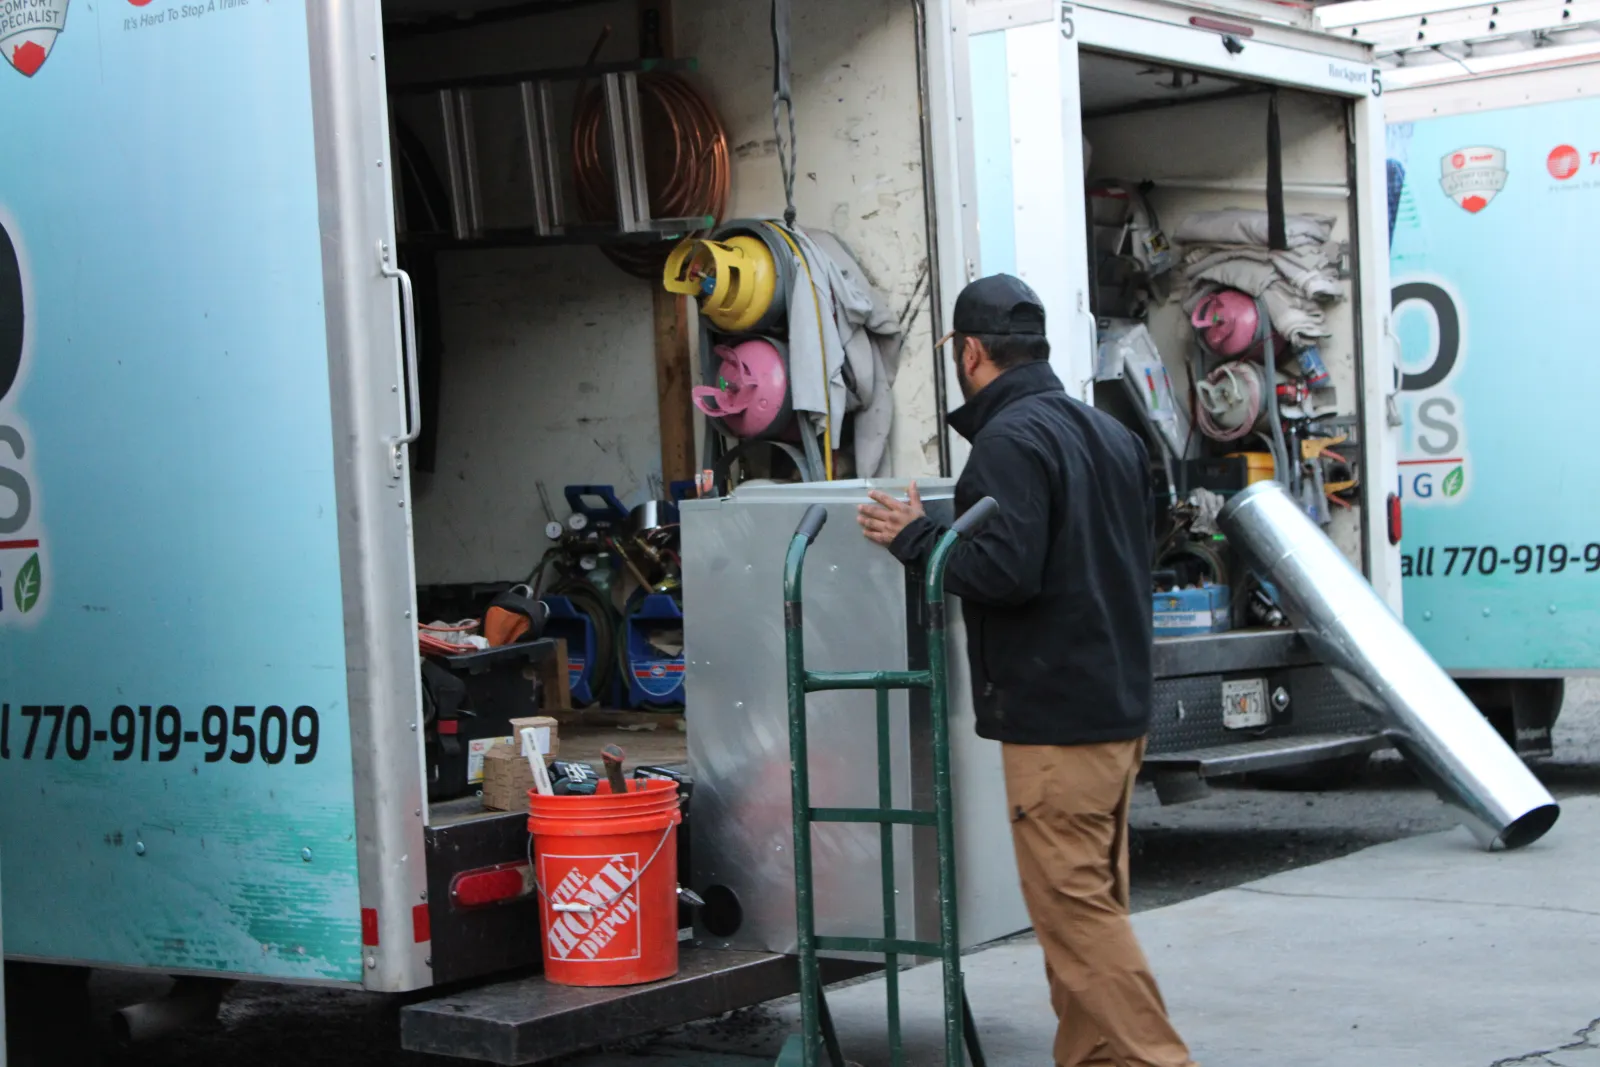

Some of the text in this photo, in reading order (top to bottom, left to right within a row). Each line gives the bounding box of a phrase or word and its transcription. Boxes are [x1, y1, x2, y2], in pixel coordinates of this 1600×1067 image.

[0, 10, 59, 34] PECIALIST
[140, 11, 164, 26] Hard
[167, 8, 179, 21] To
[181, 5, 205, 18] Stop
[207, 0, 215, 12] A
[1061, 6, 1075, 39] 5
[1371, 69, 1383, 97] 5
[1443, 543, 1600, 577] 770-919-9
[20, 704, 320, 765] 770-919-9509
[551, 866, 589, 905] THE
[548, 854, 640, 960] HOME
[577, 892, 638, 961] DEPOT
